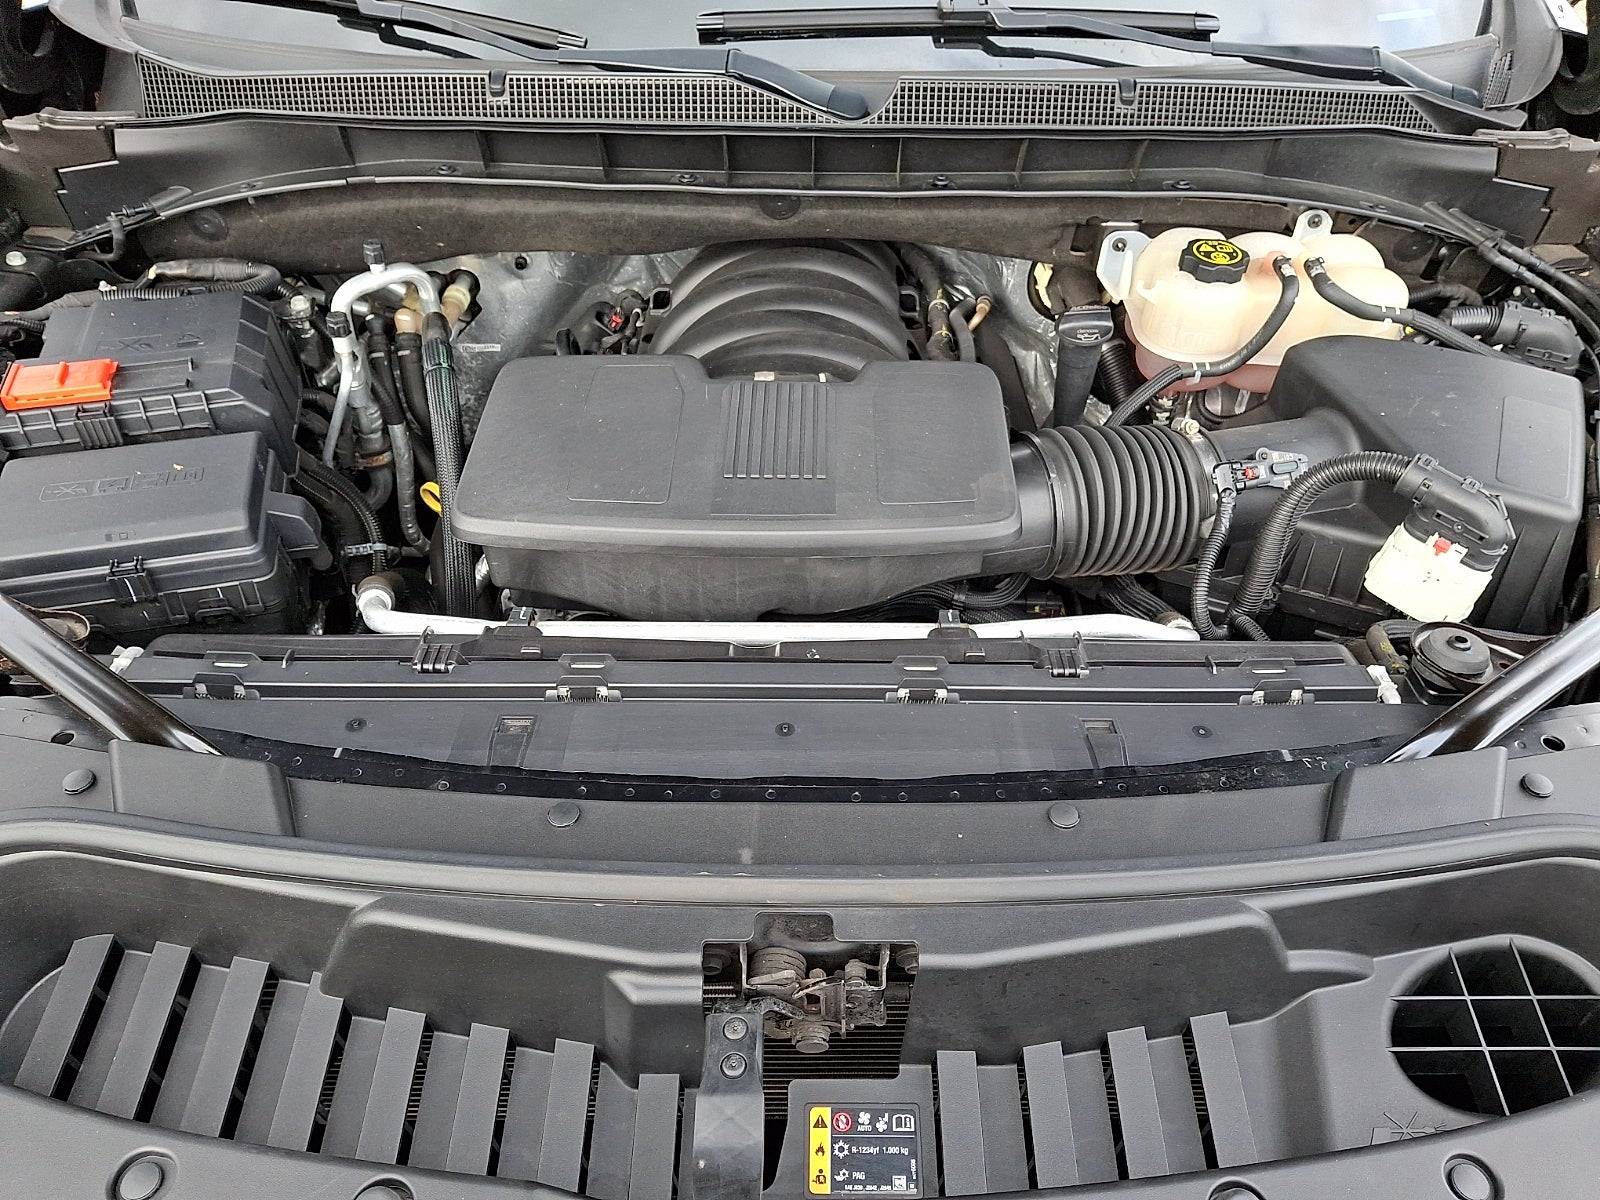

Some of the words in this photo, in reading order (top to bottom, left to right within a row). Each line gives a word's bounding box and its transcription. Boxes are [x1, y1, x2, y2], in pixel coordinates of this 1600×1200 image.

[851, 1146, 879, 1155] R-1234yf
[882, 1146, 900, 1154] 1.000
[901, 1146, 909, 1155] kg
